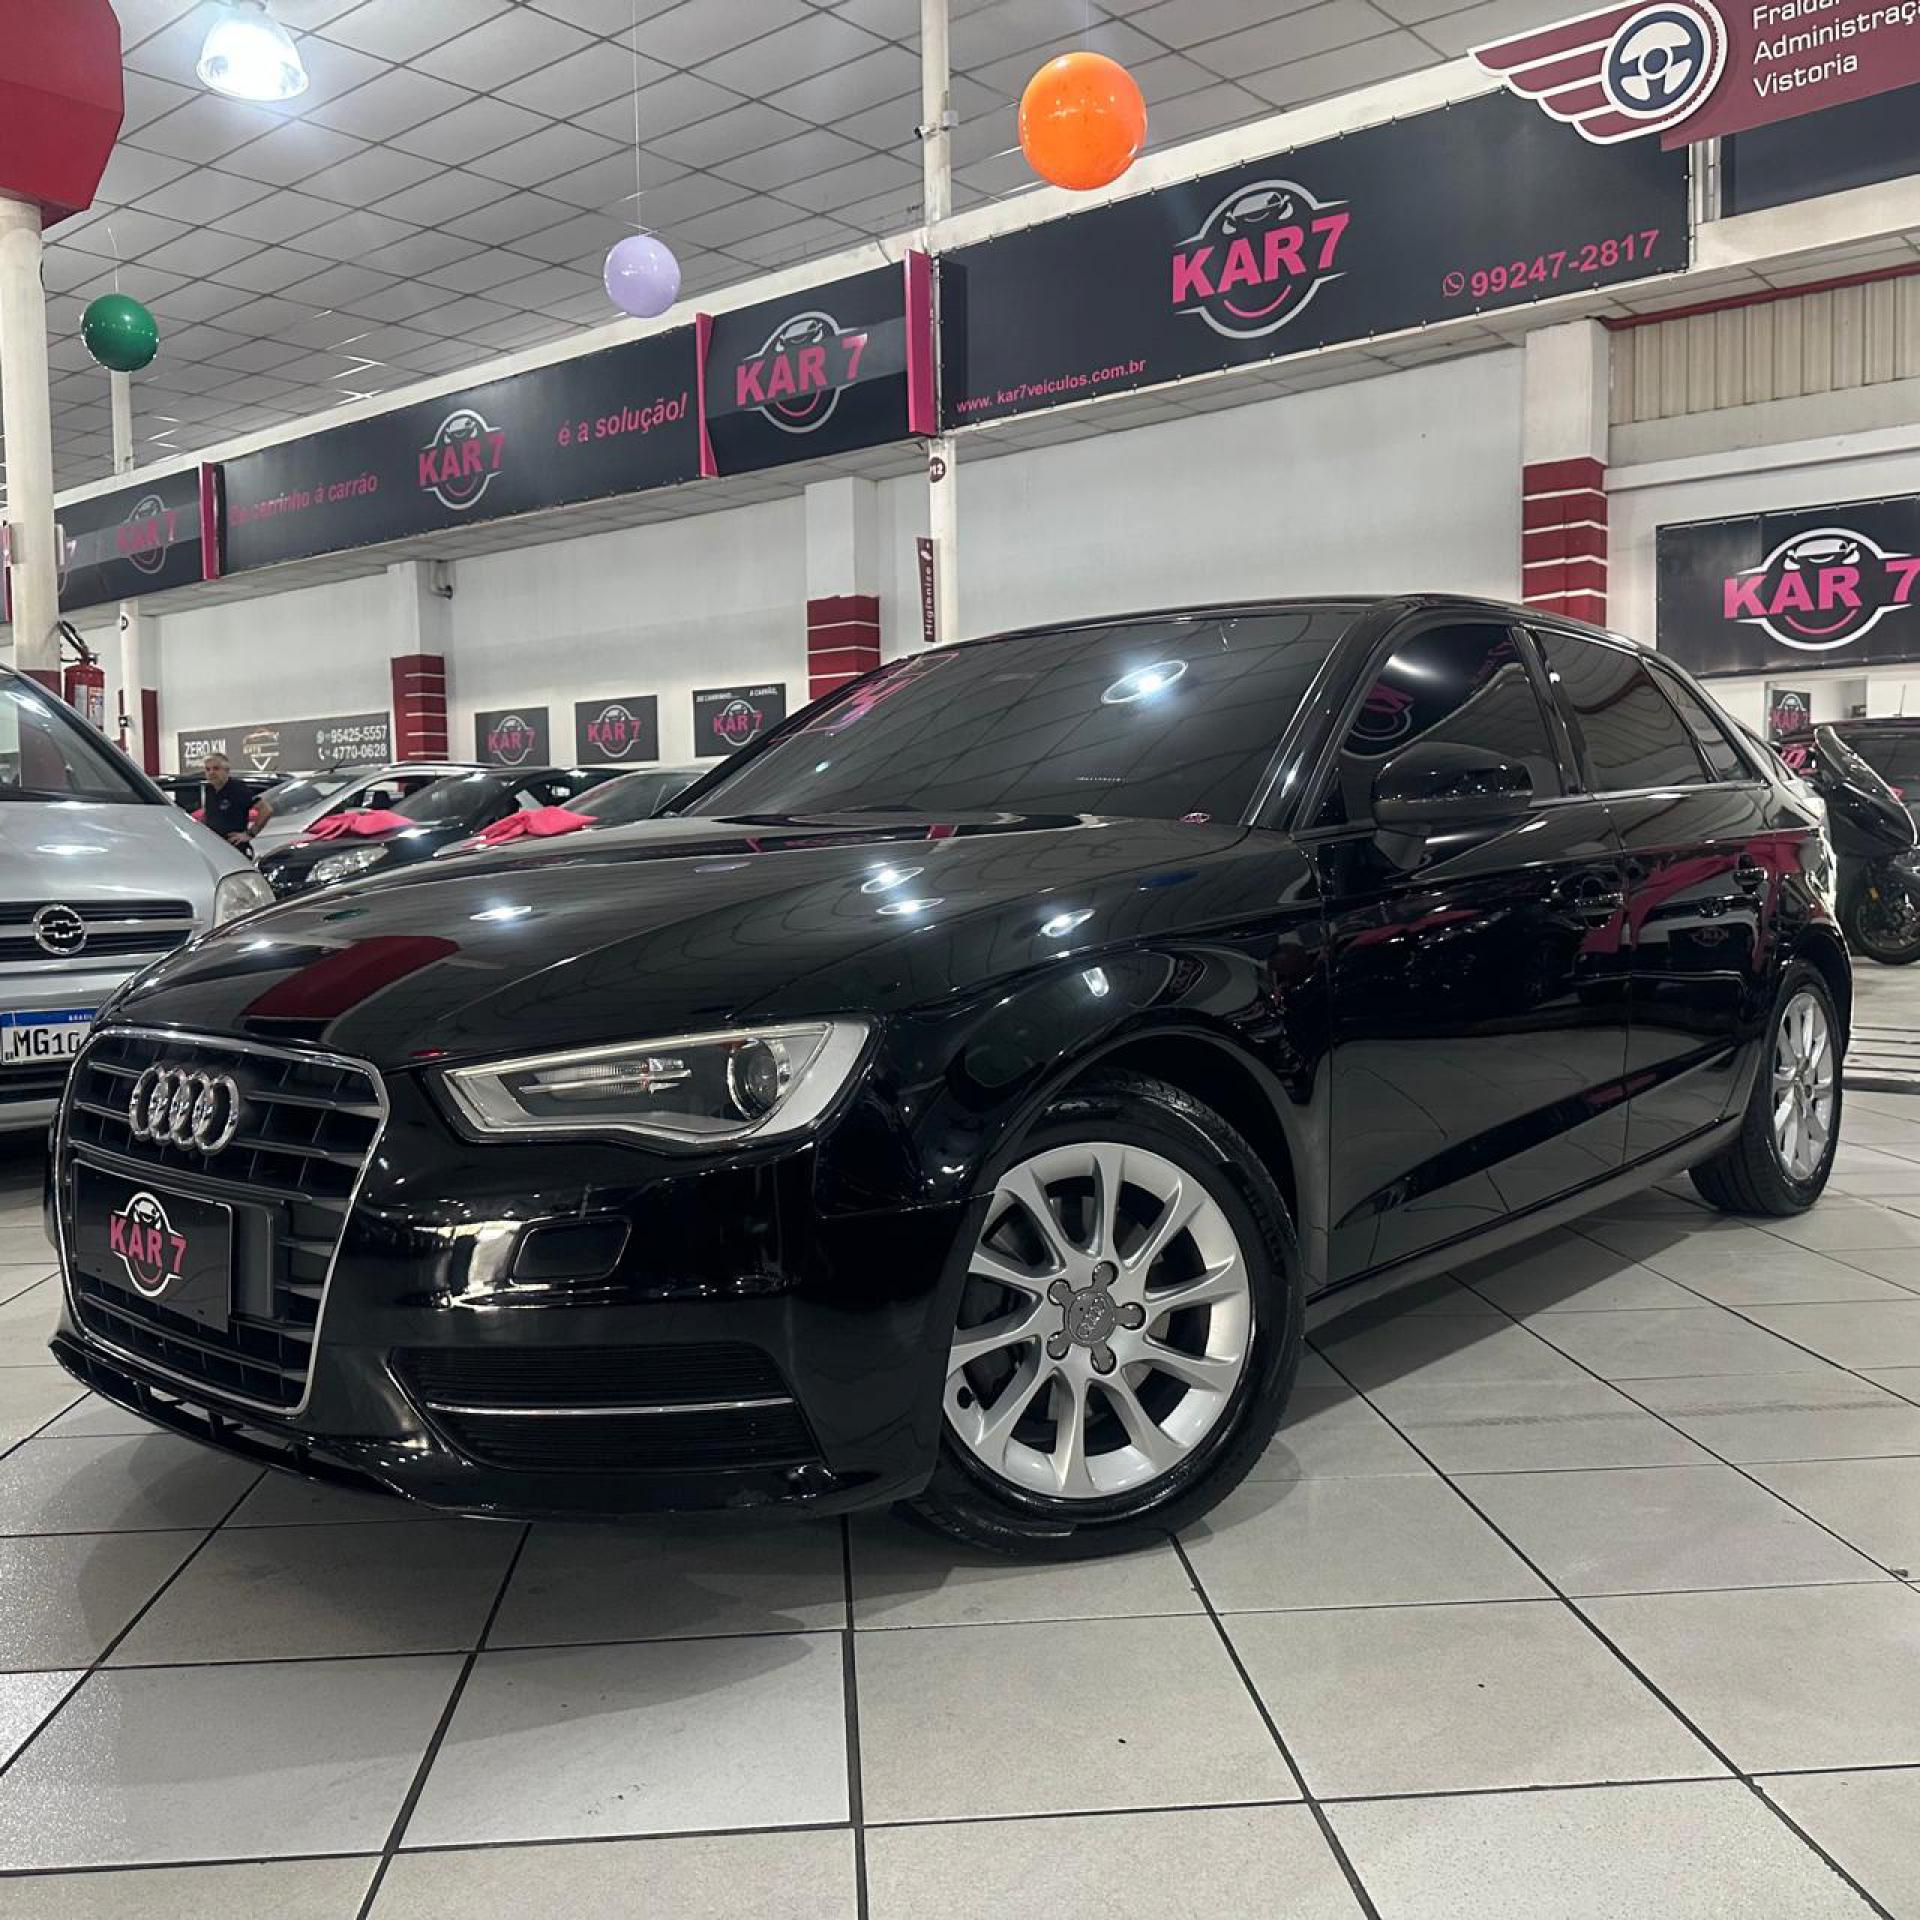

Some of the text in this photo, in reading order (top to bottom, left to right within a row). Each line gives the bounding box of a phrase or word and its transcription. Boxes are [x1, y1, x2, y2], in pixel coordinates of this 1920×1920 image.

[1753, 0, 1920, 64] Administraç
[1753, 53, 1858, 97] Vistoria
[1172, 212, 1350, 304] KAR 7
[1470, 229, 1659, 297] 99247-2817
[736, 333, 868, 406] KAR 7
[997, 359, 1147, 404] kar7veiculos.com.br
[558, 392, 688, 445] é a solução!
[418, 432, 505, 486] KAR 7
[328, 472, 378, 501] carrão
[1724, 557, 1920, 619] KAR 7
[184, 740, 210, 758] ZERO
[488, 730, 536, 750] KAR 7
[587, 720, 641, 741] KAR 7
[713, 714, 748, 733] KAR
[110, 1214, 187, 1274] KAR 7
